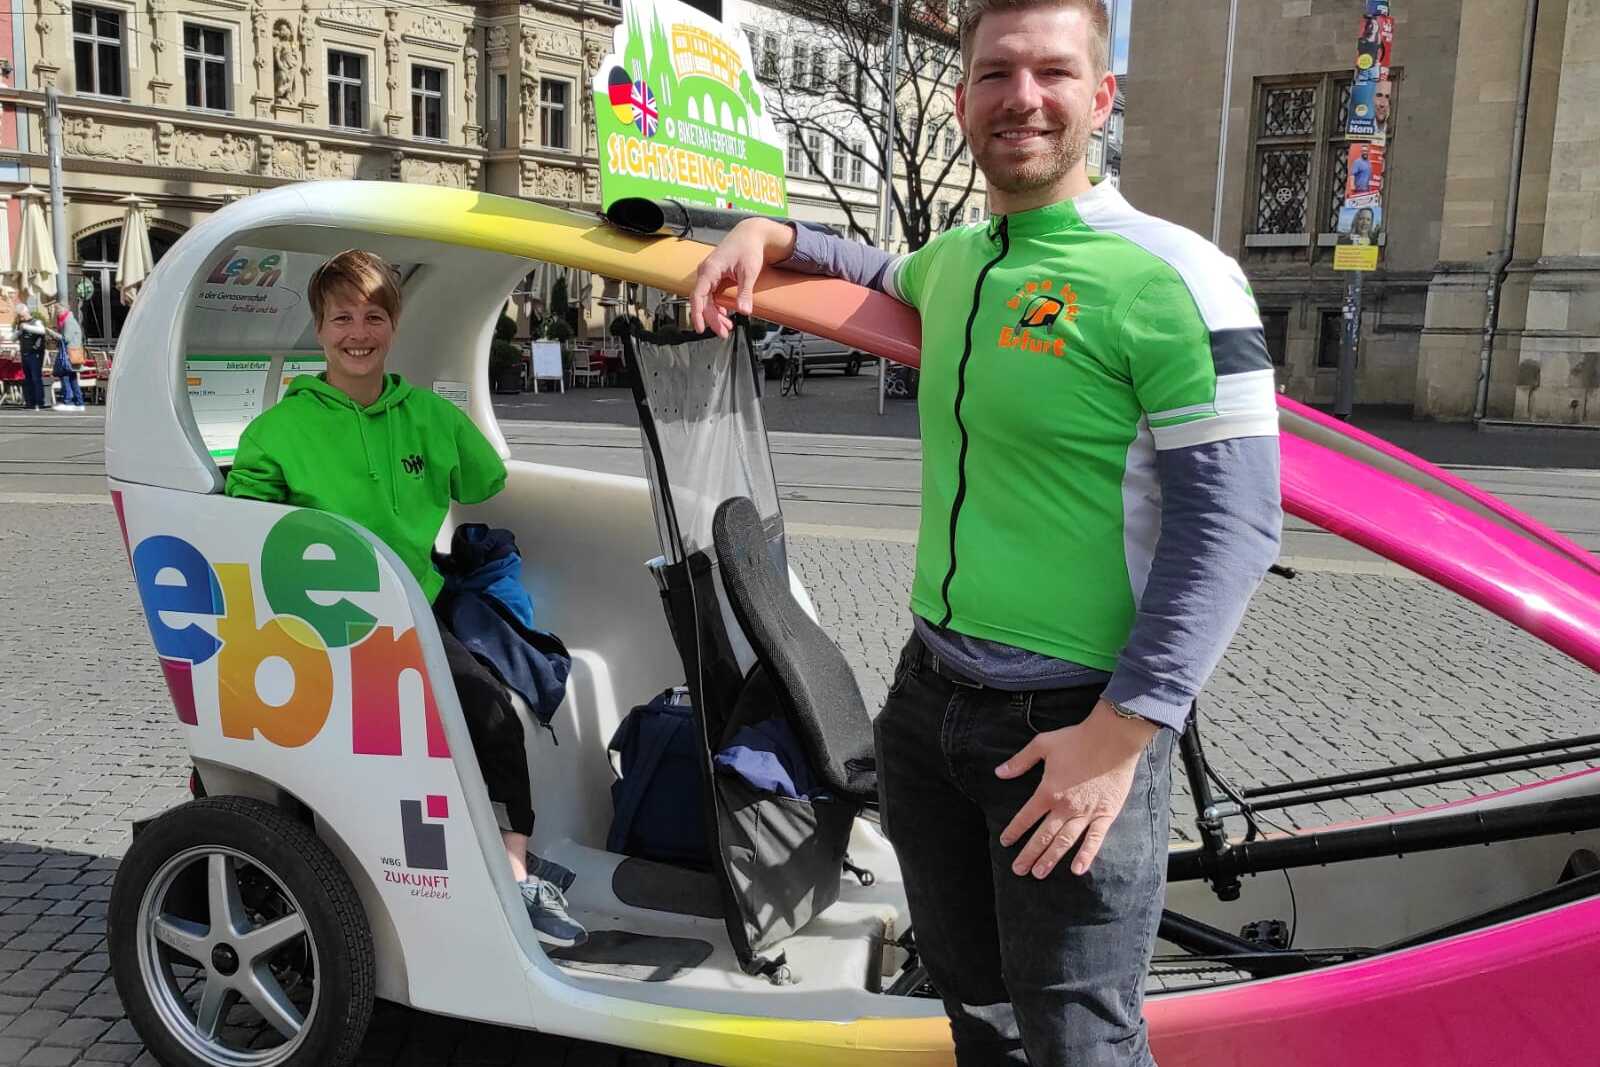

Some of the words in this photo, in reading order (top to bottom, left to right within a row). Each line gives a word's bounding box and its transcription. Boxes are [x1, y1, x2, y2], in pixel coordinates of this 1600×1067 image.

[1349, 125, 1373, 133] Horn
[607, 132, 785, 208] SIGHTSEEING-TOUREN
[206, 250, 282, 288] Leben
[998, 325, 1066, 357] Erfurt
[381, 856, 401, 867] WBG
[383, 869, 449, 889] ZUKUNFT
[410, 886, 452, 900] erleben
